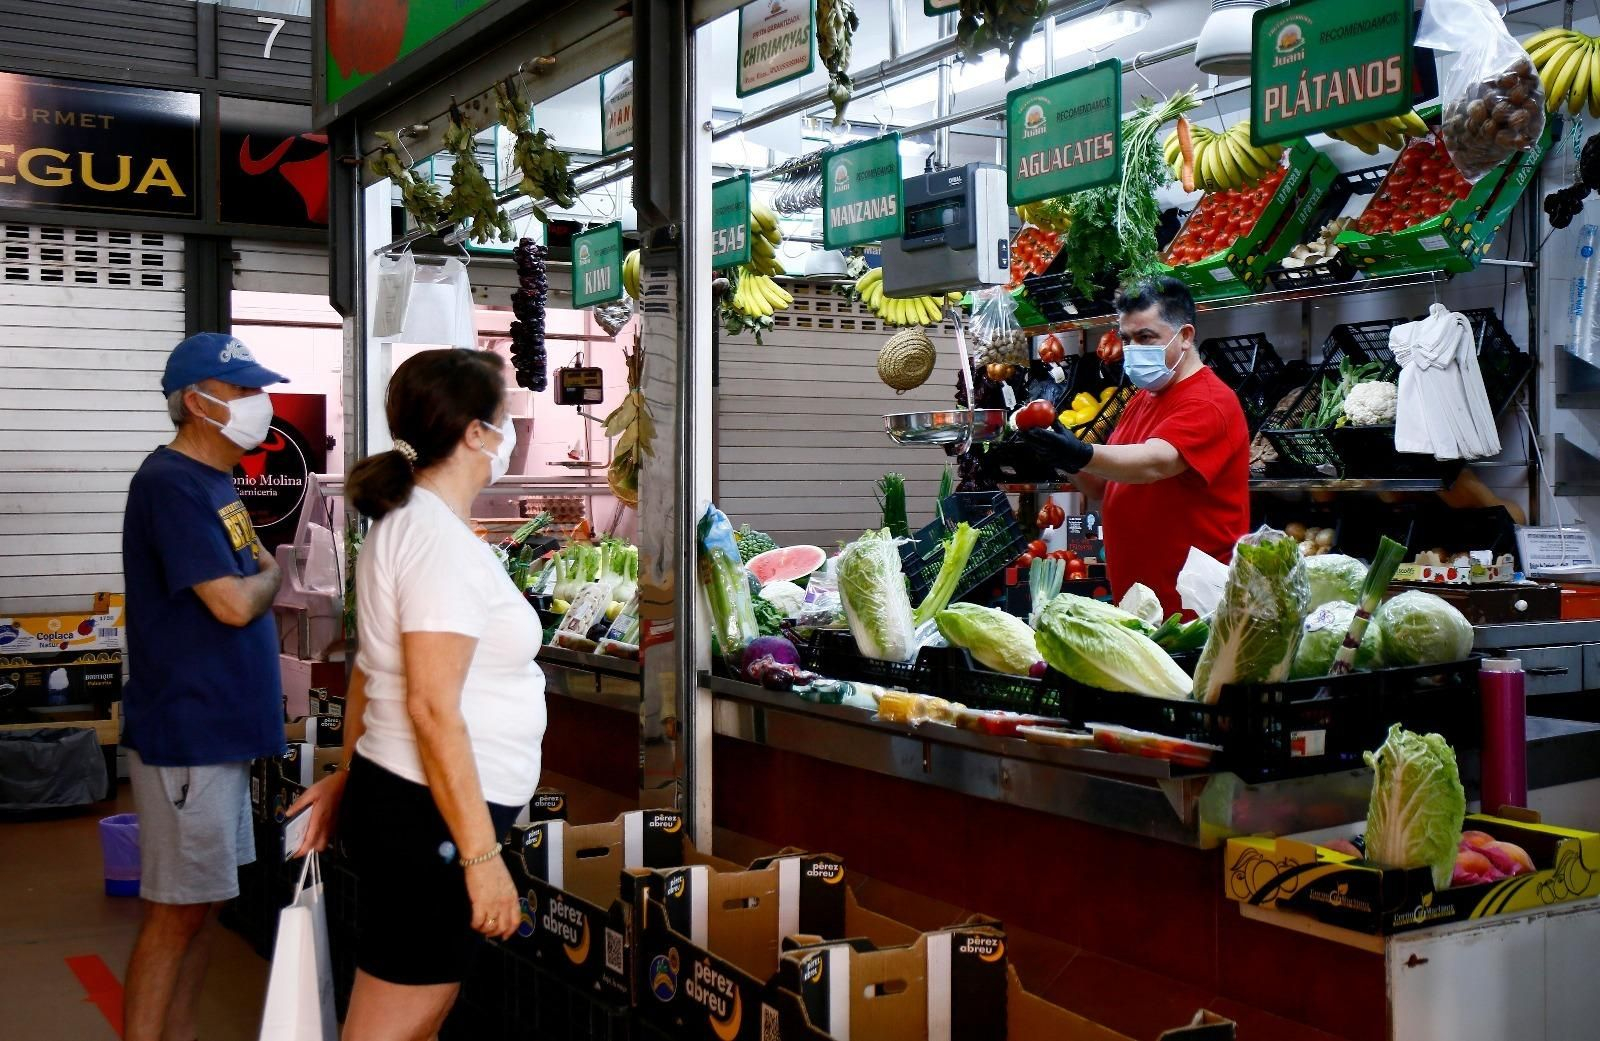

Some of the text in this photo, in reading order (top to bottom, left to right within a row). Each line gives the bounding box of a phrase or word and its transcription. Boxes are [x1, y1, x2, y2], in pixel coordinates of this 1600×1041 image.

[257, 16, 286, 59] 7
[743, 25, 810, 68] CHIRIMOYAS
[1272, 48, 1305, 68] Juani
[1264, 55, 1402, 124] PLÁTANOS
[3, 105, 115, 129] URMET
[1017, 132, 1113, 180] AGUACATES
[830, 194, 896, 228] MANZANAS
[712, 224, 746, 256] ESAS
[236, 488, 278, 496] arniceria
[260, 474, 302, 486] Molina
[36, 632, 74, 642] Coplaca
[806, 869, 834, 877] abreu
[544, 914, 577, 943] abreu
[960, 944, 992, 954] abreu
[686, 978, 726, 1017] abreu
